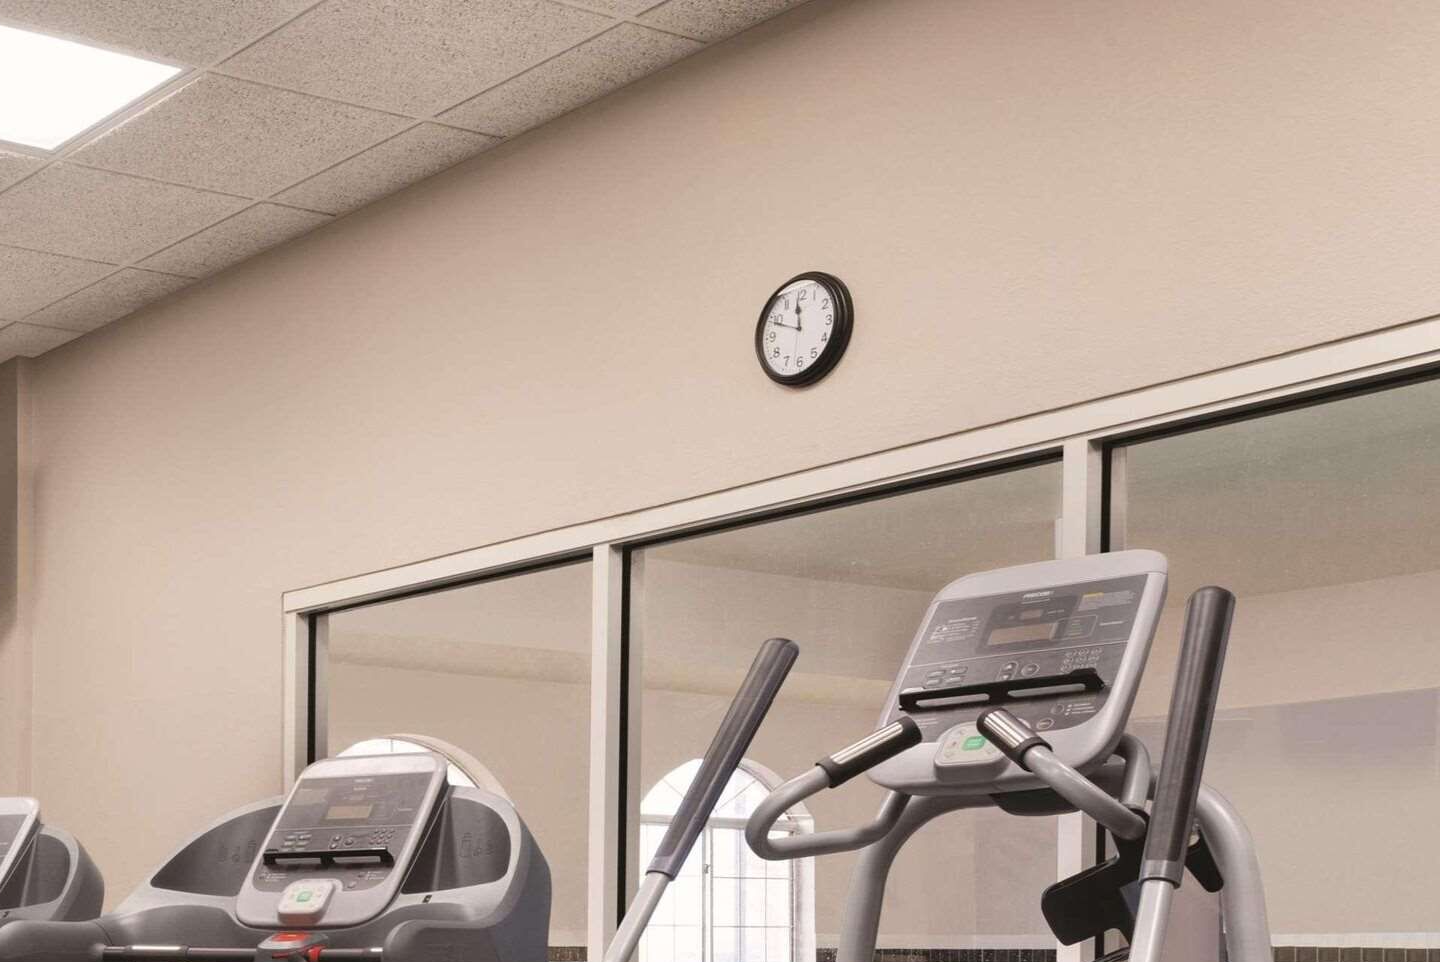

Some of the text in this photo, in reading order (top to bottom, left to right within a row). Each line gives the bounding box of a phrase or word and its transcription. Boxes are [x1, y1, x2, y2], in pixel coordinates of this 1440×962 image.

[822, 297, 830, 310] 2
[825, 313, 833, 326] 3
[769, 331, 777, 343] 9
[821, 331, 828, 342] 4
[773, 346, 781, 358] 8
[810, 347, 818, 359] 5
[783, 355, 791, 367] 7
[796, 355, 804, 368] 6
